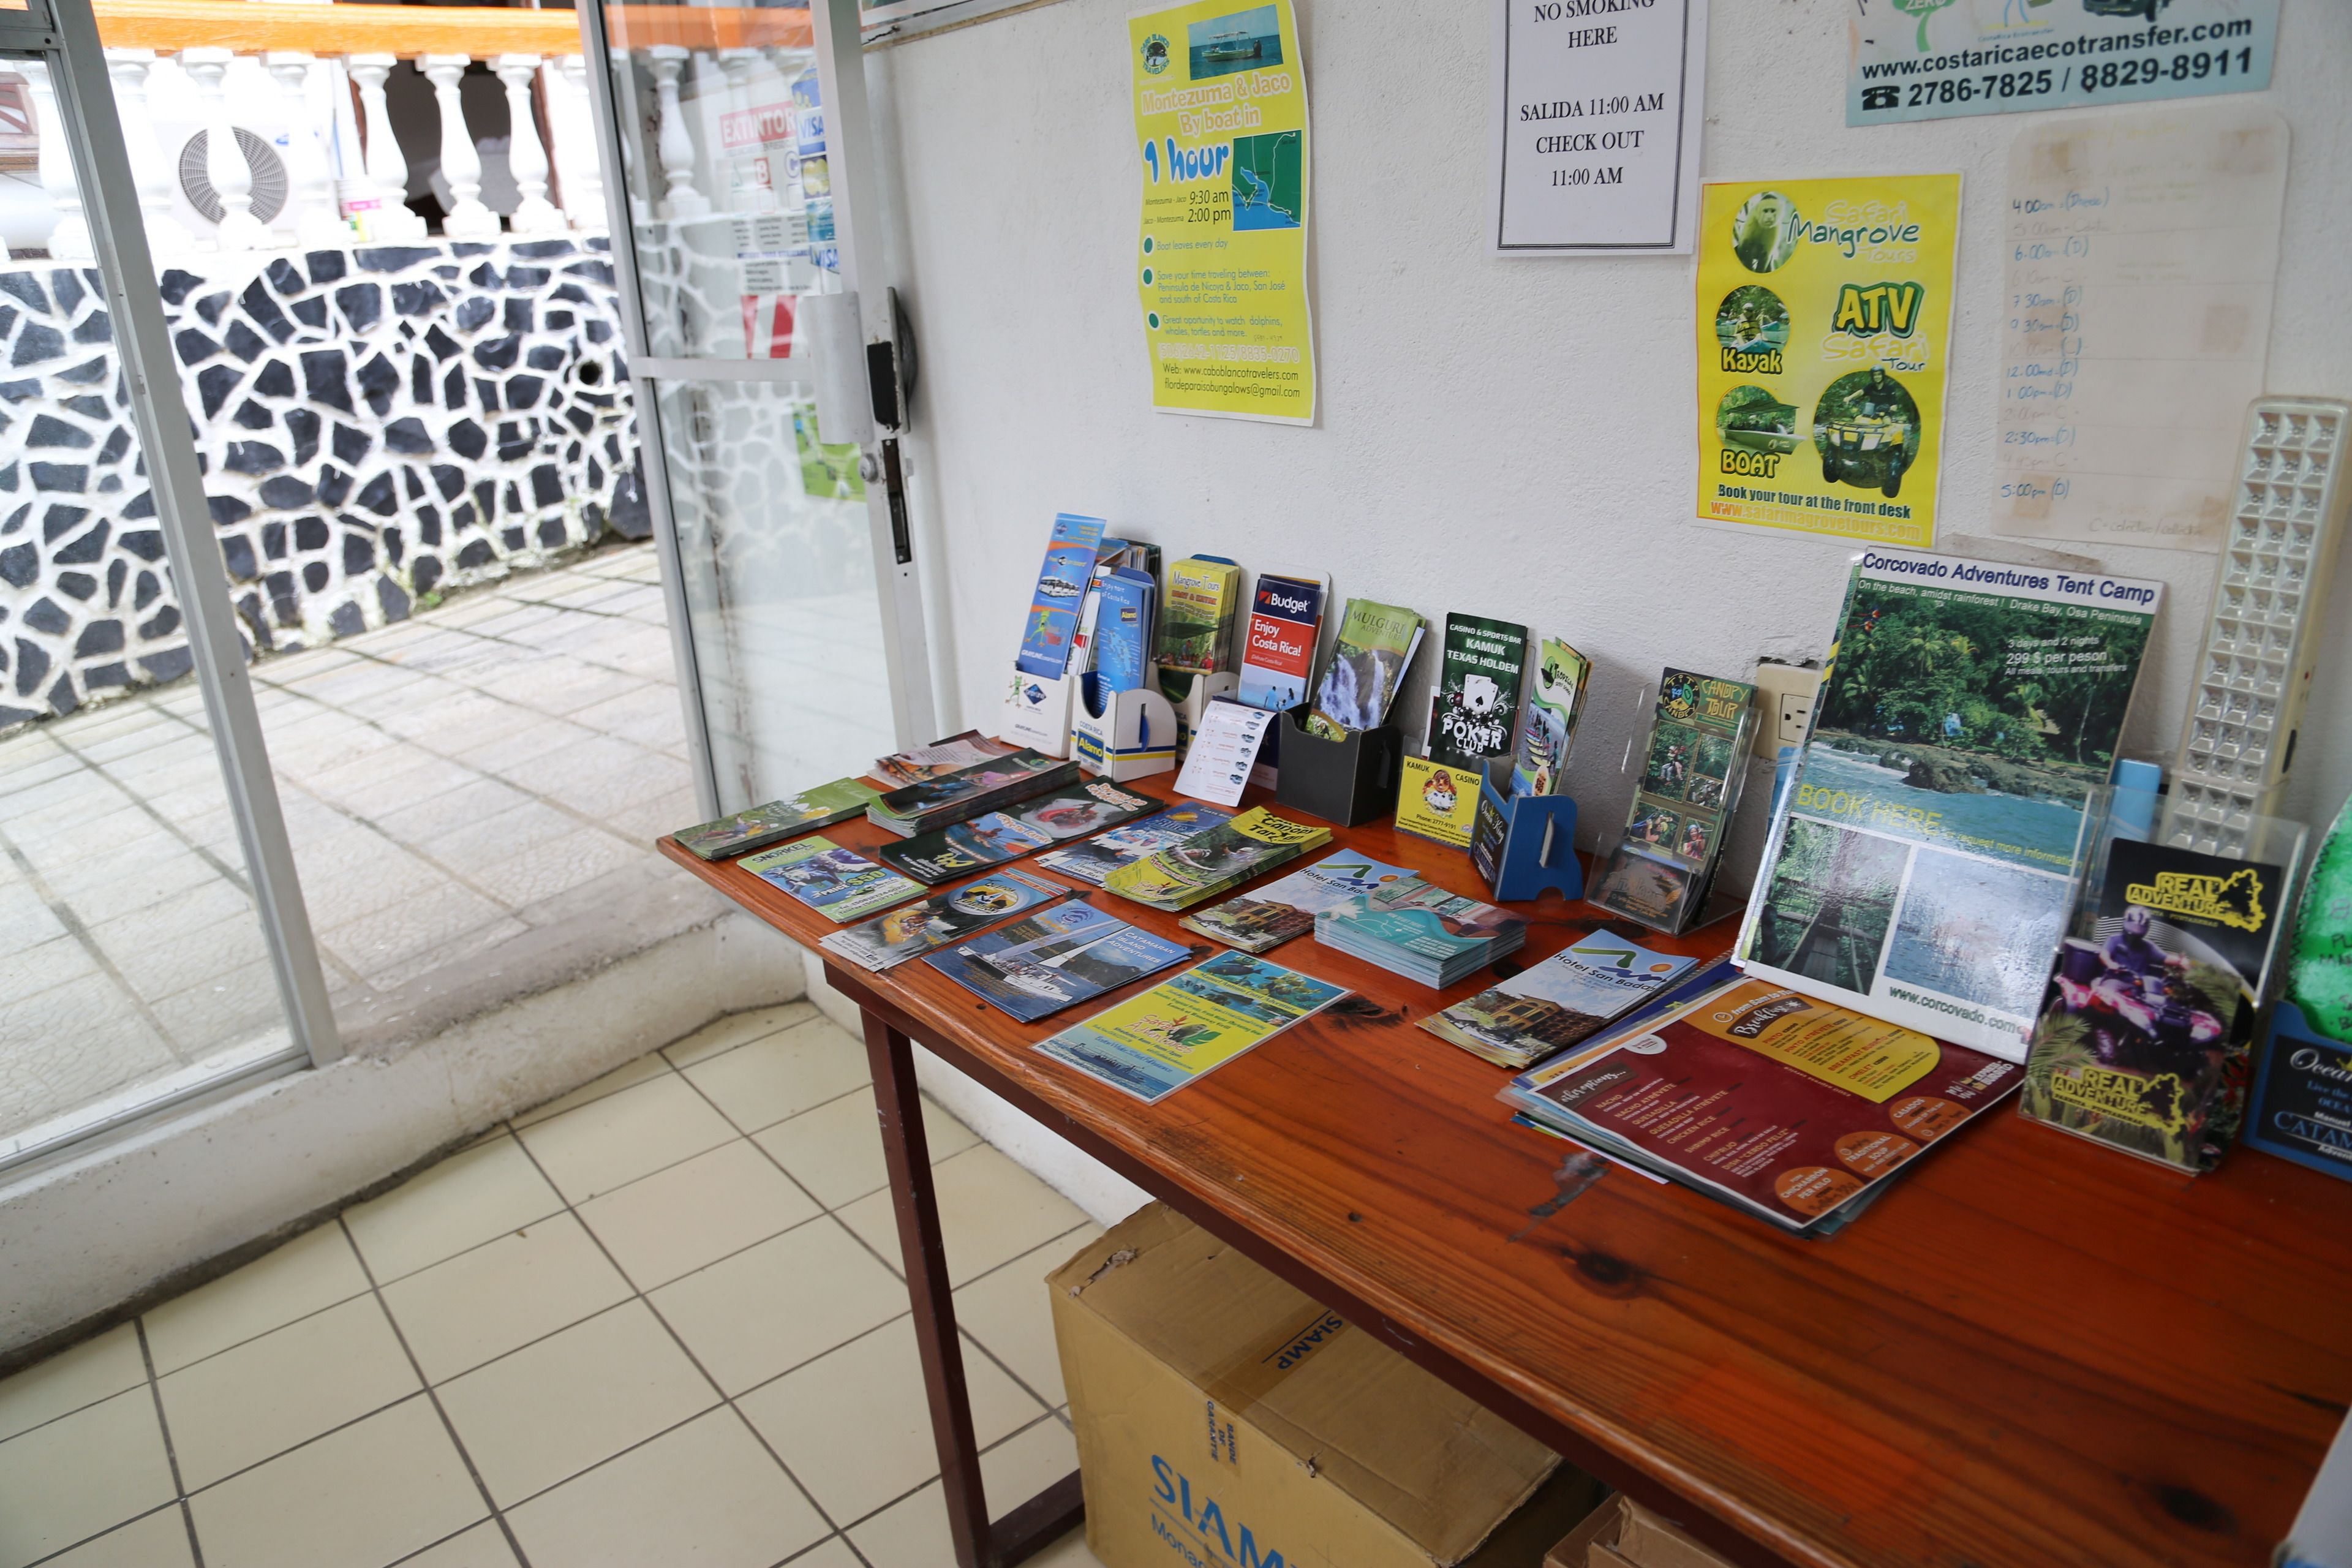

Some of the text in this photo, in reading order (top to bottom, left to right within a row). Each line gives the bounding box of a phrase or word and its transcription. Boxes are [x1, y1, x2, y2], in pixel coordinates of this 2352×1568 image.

[1533, 3, 1561, 23] NO
[1567, 26, 1618, 49] HERE
[1861, 18, 2253, 80] www.costaricaecotransfer.com
[1907, 46, 2253, 108] 2786-7825 8829-8911
[1142, 74, 1292, 114] Montezuma & Jaco
[1520, 92, 1665, 122] SALIDA 11:00 AM
[724, 107, 796, 144] EXTINTOR
[801, 115, 824, 139] VISA
[1179, 106, 1261, 137] By boat in
[1536, 129, 1645, 154] CHECK OUT
[1144, 138, 1230, 183] 1 hour
[1551, 166, 1624, 187] 11:00 AM
[1145, 197, 1173, 206] Montezuma
[1189, 189, 1210, 206] 9:30
[1212, 190, 1229, 203] am
[1156, 207, 1232, 225] Montezuma 2:00 pm
[1824, 199, 1909, 225] Safari
[1156, 236, 1229, 252] Boat leaves every day
[1786, 211, 1920, 259] Mangrove
[1156, 268, 1270, 282] Save your time traveling between:
[1157, 279, 1286, 293] Peninsula de Nicoya & San José
[1158, 293, 1238, 304] and south of Costa Rica
[1831, 281, 1926, 339] ATV
[1162, 314, 1246, 325] Great to watch
[1212, 327, 1226, 337] and
[1821, 331, 1931, 361] Safari
[1163, 363, 1299, 381] Web: www.caboblancotravelers.com
[1721, 347, 1784, 375] Kayak
[1881, 357, 1926, 372] Tour
[1164, 377, 1301, 398] flordeparaisobungalows@gmail.com
[1720, 448, 1781, 479] BOAT
[1717, 483, 1912, 519] Book your tour at the front desk
[1173, 570, 1220, 591] Mangrove Tours
[1863, 552, 2155, 606] Corcovado Adventures Tent Camp
[1270, 592, 1309, 614] Budget
[1857, 579, 2143, 626] On the beach, amidst rainforest Drake Bay, Osa Peninsula
[1120, 611, 1138, 620] Alamo
[1254, 619, 1280, 638] Enjoy
[1360, 624, 1403, 642] ADVENTURE
[1449, 623, 1476, 636] CASINO
[1482, 630, 1509, 643] SPORTS
[1508, 635, 1522, 646] BAR
[1252, 635, 1302, 657] Costa Rica!
[1466, 638, 1507, 657] KAMUK
[2008, 635, 2100, 651] 3 days and 2 nights
[1446, 649, 1520, 675] TEXAS HOLDEM
[2004, 662, 2128, 676] All tours and transfers
[2005, 650, 2108, 668] 299 $ per peson
[1702, 679, 1750, 703] CANOPY
[1705, 697, 1738, 720] TOUR
[1441, 717, 1502, 751] POKER
[1455, 737, 1485, 754] CLUB
[1078, 737, 1104, 758] Alamo
[1406, 760, 1480, 786] KAMUK CASINO
[1797, 783, 1943, 837] BOOK HERE
[752, 843, 813, 864] SNORKEL
[1996, 841, 2023, 856] more
[819, 870, 887, 897] PRICE $50
[1299, 867, 1348, 890] Hotel San
[2159, 875, 2219, 900] REAL
[2128, 885, 2226, 916] ADVENTURE
[1106, 939, 1162, 964] ADVENTURES
[1115, 935, 1147, 951] ISLAND
[1125, 932, 1177, 955] CATAMARAN
[1553, 952, 1590, 972] Hotel
[1588, 970, 1614, 982] San
[1140, 1014, 1182, 1033] Safari
[1827, 1049, 1864, 1072] BREAKFAST
[1847, 1063, 1875, 1080] OMELET
[2084, 1069, 2144, 1098] REAL
[1595, 1094, 1624, 1109] NACHO
[1893, 1098, 1926, 1118] CASADOS
[2053, 1076, 2150, 1117] ADVENTURE
[1614, 1102, 1642, 1118] NACHO
[1632, 1100, 1678, 1125] QUESADILLA
[1649, 1109, 1695, 1135] QUESADILLA
[1666, 1115, 1717, 1145] CHICKEN RICE
[1710, 1126, 1730, 1139] RICE
[1845, 1135, 1893, 1163] TRADITIONAL
[1869, 1147, 1889, 1161] SOUP
[1797, 1188, 1816, 1200] PER
[1814, 1177, 1833, 1191] KILO
[1276, 1315, 1344, 1370] SIAMP
[1206, 1400, 1219, 1463] GARANTIE
[1217, 1429, 1226, 1447] DE
[1226, 1422, 1237, 1466] BANDE
